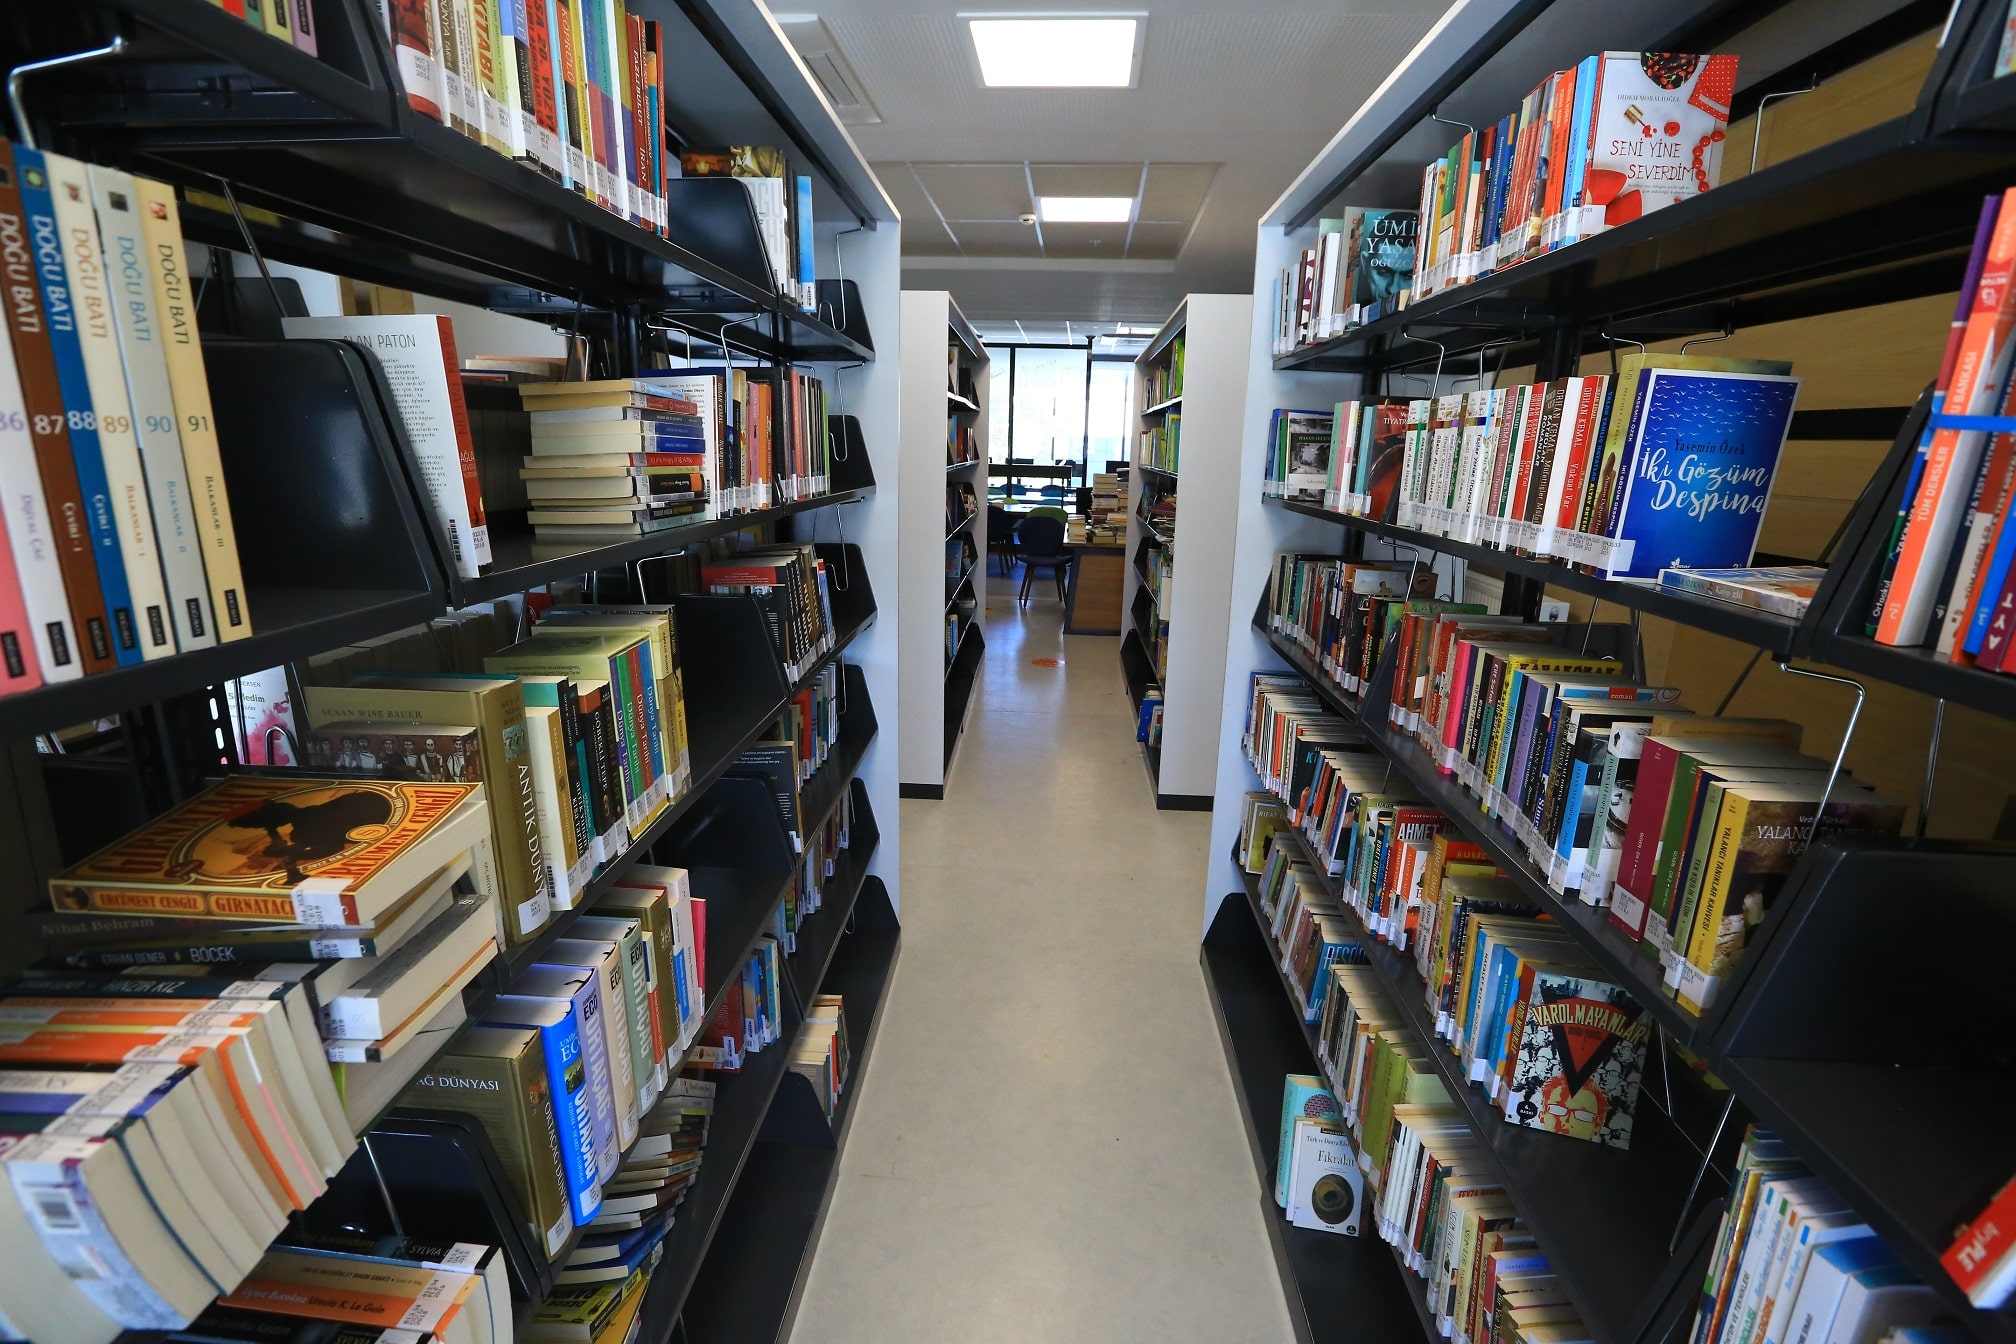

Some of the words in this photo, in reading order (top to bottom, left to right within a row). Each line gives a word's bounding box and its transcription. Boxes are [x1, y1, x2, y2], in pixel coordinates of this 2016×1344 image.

[1609, 137, 1643, 157] SENİ
[1650, 138, 1682, 158] YİNE
[1627, 163, 1695, 181] SEVERDİM
[1372, 215, 1417, 236] ÜMİ
[0, 212, 31, 281] DOĞU
[32, 215, 64, 281] DOĞU
[71, 228, 100, 290] DOĞU
[1366, 237, 1416, 251] YAŞA
[116, 236, 142, 295] DOĞU
[158, 244, 181, 300] DOĞU
[11, 285, 41, 333] BATI
[46, 285, 73, 332] BATI
[84, 295, 108, 338] BATI
[128, 301, 152, 342] BATI
[167, 307, 190, 344] BATI
[377, 333, 416, 349] PATON
[1955, 351, 1978, 403] BANKASI
[1504, 395, 1515, 420] ORHAN
[1551, 388, 1564, 420] ORHAN
[1579, 386, 1592, 415] ORHAN
[34, 414, 65, 435] 87
[67, 410, 97, 431] 88
[103, 415, 129, 434] 89
[146, 415, 172, 433] 90
[188, 415, 208, 432] 91
[1499, 422, 1510, 448] KEMAL
[1573, 418, 1586, 448] KEMAL
[1535, 415, 1548, 467] ROMANLAR
[1541, 415, 1553, 463] KAYBOLAN
[1545, 423, 1558, 454] KEMAL
[1673, 438, 1716, 454] Yasemin
[1566, 462, 1578, 491] Vukuat
[1638, 447, 1672, 483] İki
[1678, 454, 1768, 488] Gözüm
[1586, 483, 1594, 504] ALTAY
[1917, 491, 1932, 522] TÜM
[1925, 445, 1949, 497] DERSLER
[205, 476, 221, 530] BALKANLAR
[1563, 493, 1572, 508] Var
[1650, 480, 1767, 522] Despina
[1872, 579, 1890, 617] Ortaokul
[321, 708, 352, 718] SUSAN
[358, 708, 384, 718] WISE
[388, 710, 422, 719] BAUER
[517, 763, 537, 834] ANTİK
[527, 834, 546, 895] DÜNY
[1398, 823, 1439, 840] AHMET
[1717, 826, 1733, 859] YALANCI
[1756, 825, 1812, 840] YALANC
[315, 826, 419, 879] RCÜMENT
[1692, 858, 1701, 872] TEK
[1708, 859, 1725, 897] TANIKLAR
[101, 893, 155, 909] ERCÜMENT
[160, 893, 199, 909] CENGİZ
[1681, 897, 1693, 917] ÖLÜM
[1701, 897, 1717, 930] KAHVESİ
[91, 916, 155, 931] Behram
[630, 942, 643, 966] ECO
[583, 994, 598, 1022] ECO
[631, 961, 653, 1059] ORTAÇAĞ
[612, 989, 632, 1088] ORTAÇAĞ
[1531, 1003, 1649, 1045] VAROLMAYANLAR
[438, 1077, 500, 1091] DÜNYASI
[585, 1016, 610, 1122] ORTAÇAĞ
[575, 1087, 599, 1181] ORTAÇAĞ
[1317, 1150, 1355, 1166] Fıkralar
[410, 1244, 442, 1257] SYLVIA
[307, 1295, 338, 1309] Ursula
[349, 1300, 361, 1311] Le
[363, 1301, 386, 1315] Guin
